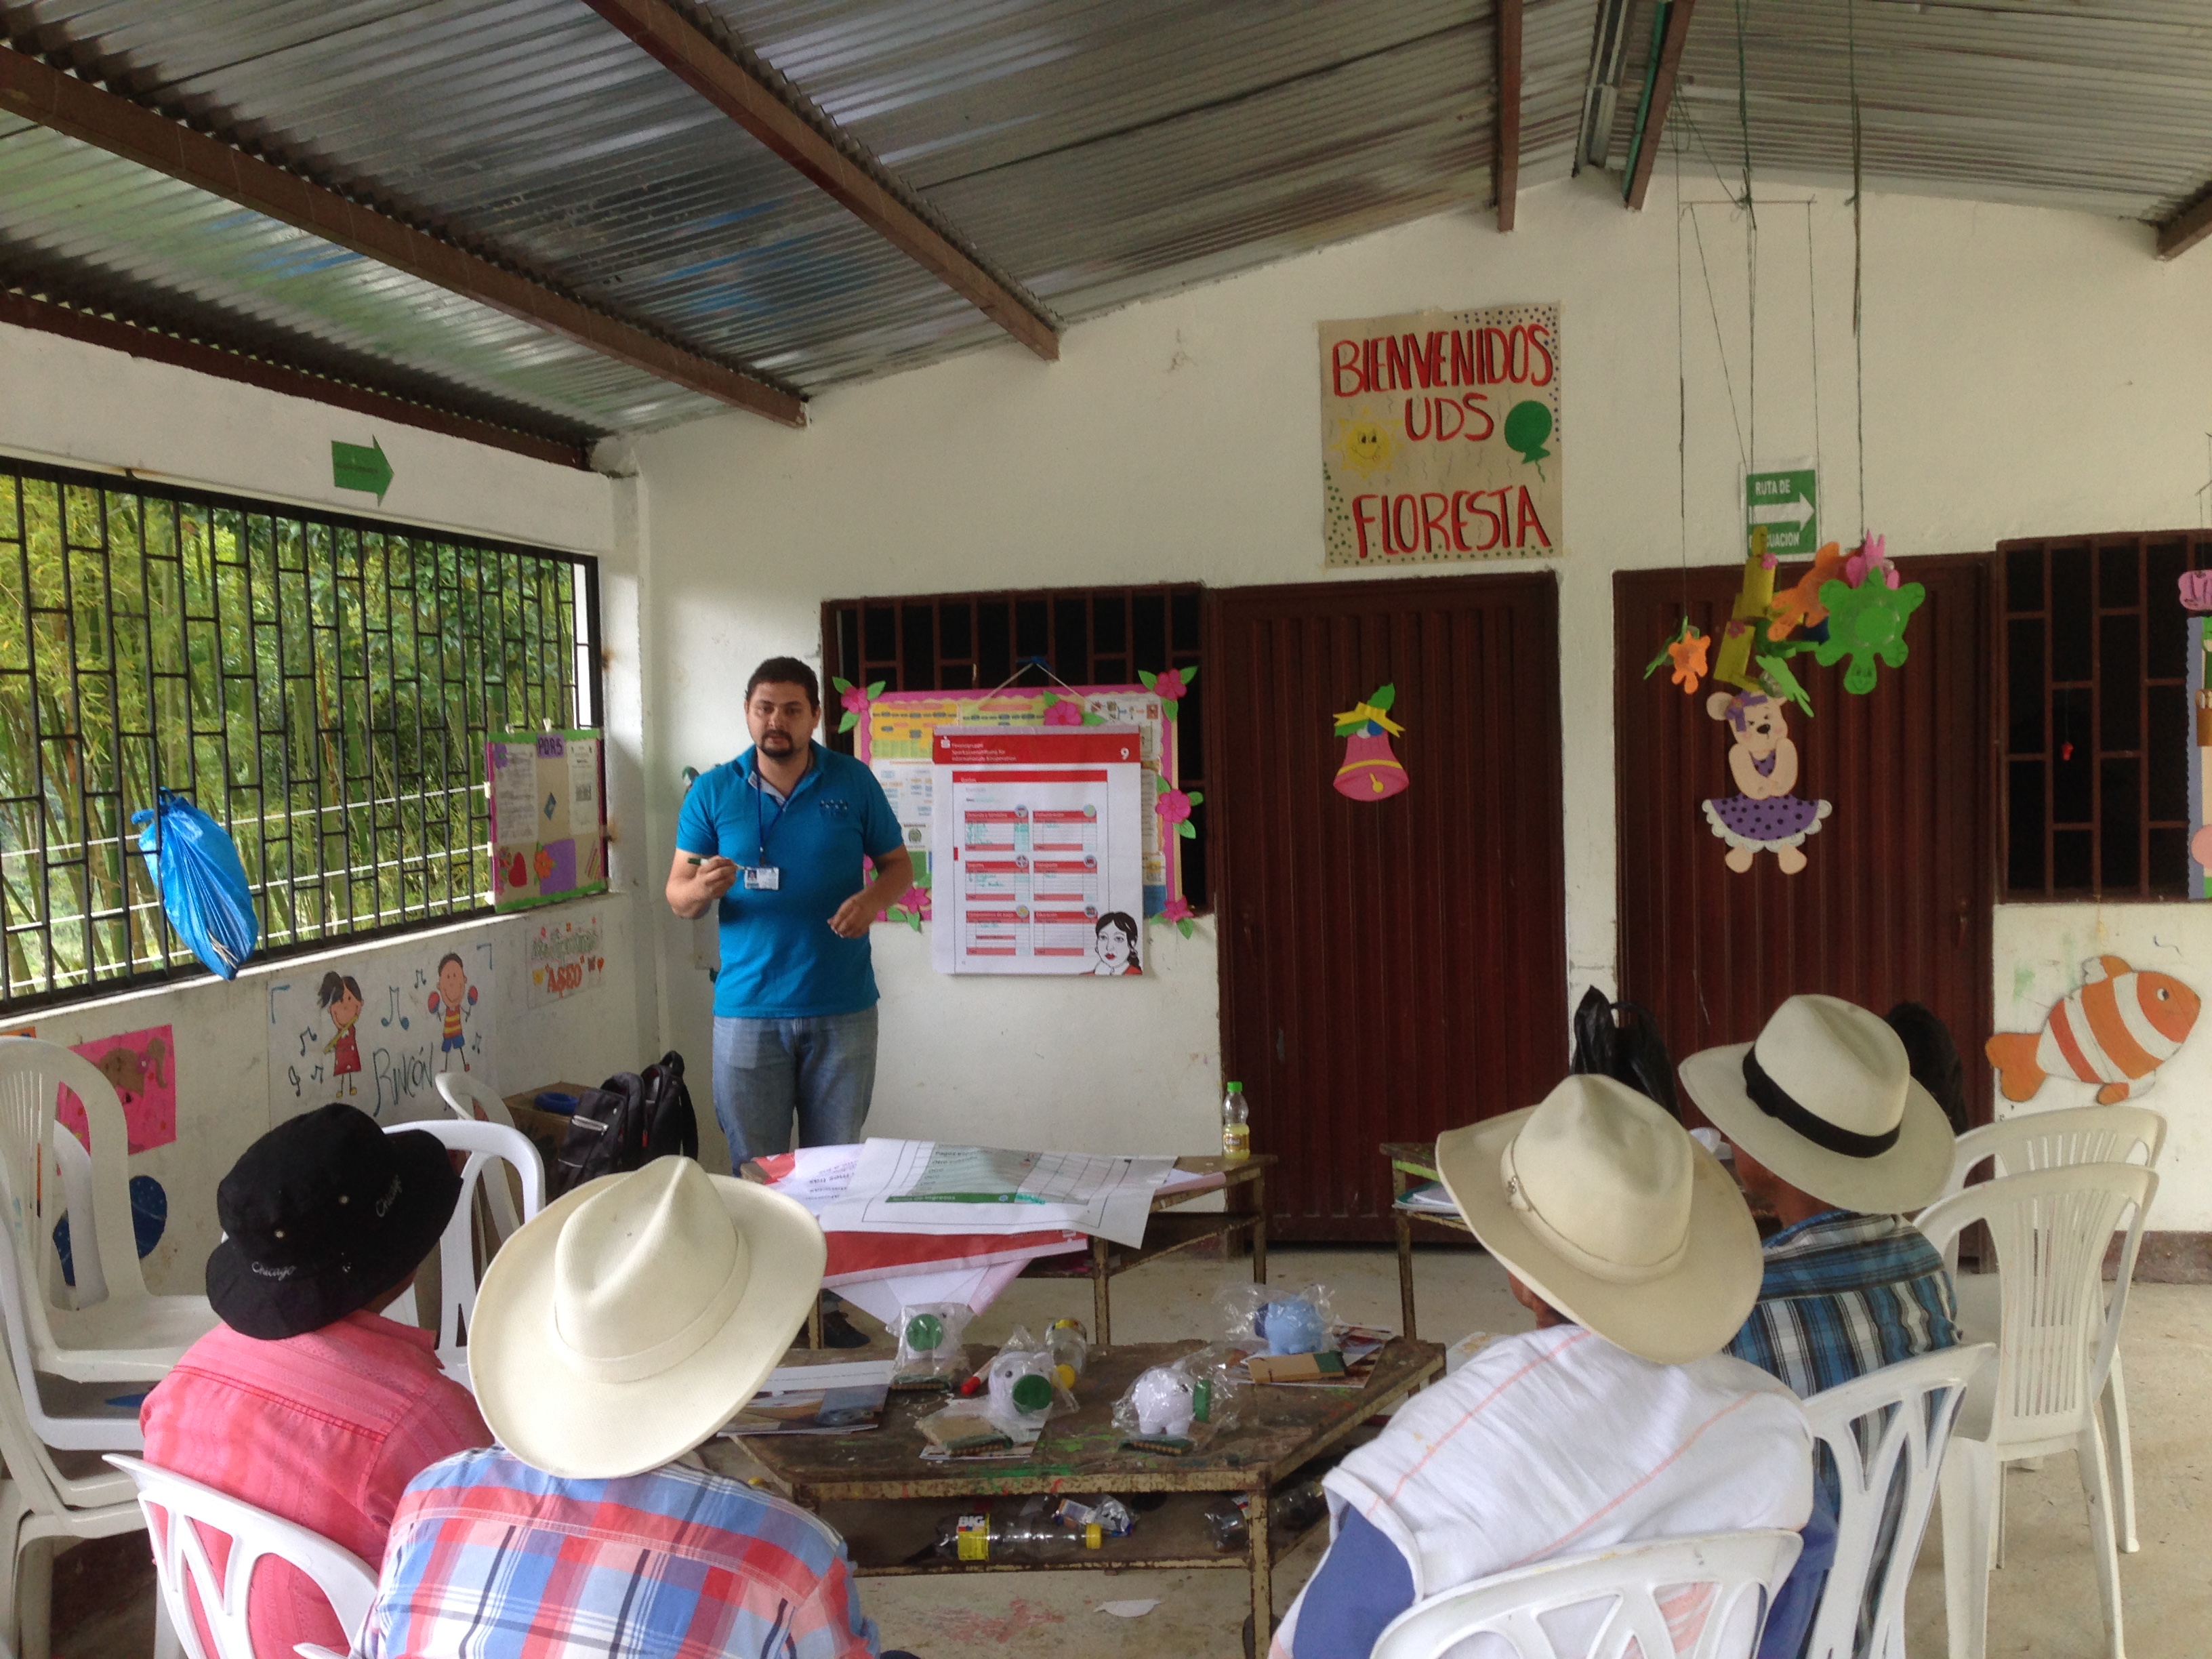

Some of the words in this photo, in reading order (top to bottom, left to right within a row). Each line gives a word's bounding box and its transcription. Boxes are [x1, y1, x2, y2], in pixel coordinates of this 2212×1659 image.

[1332, 324, 1553, 397] BIENVENIDOS
[1405, 392, 1494, 441] UDS
[1755, 480, 1778, 495] RUTA
[1779, 478, 1790, 494] DE
[1352, 485, 1552, 558] FLORESTA
[1120, 747, 1130, 760] 9
[251, 1261, 297, 1281] Chicago
